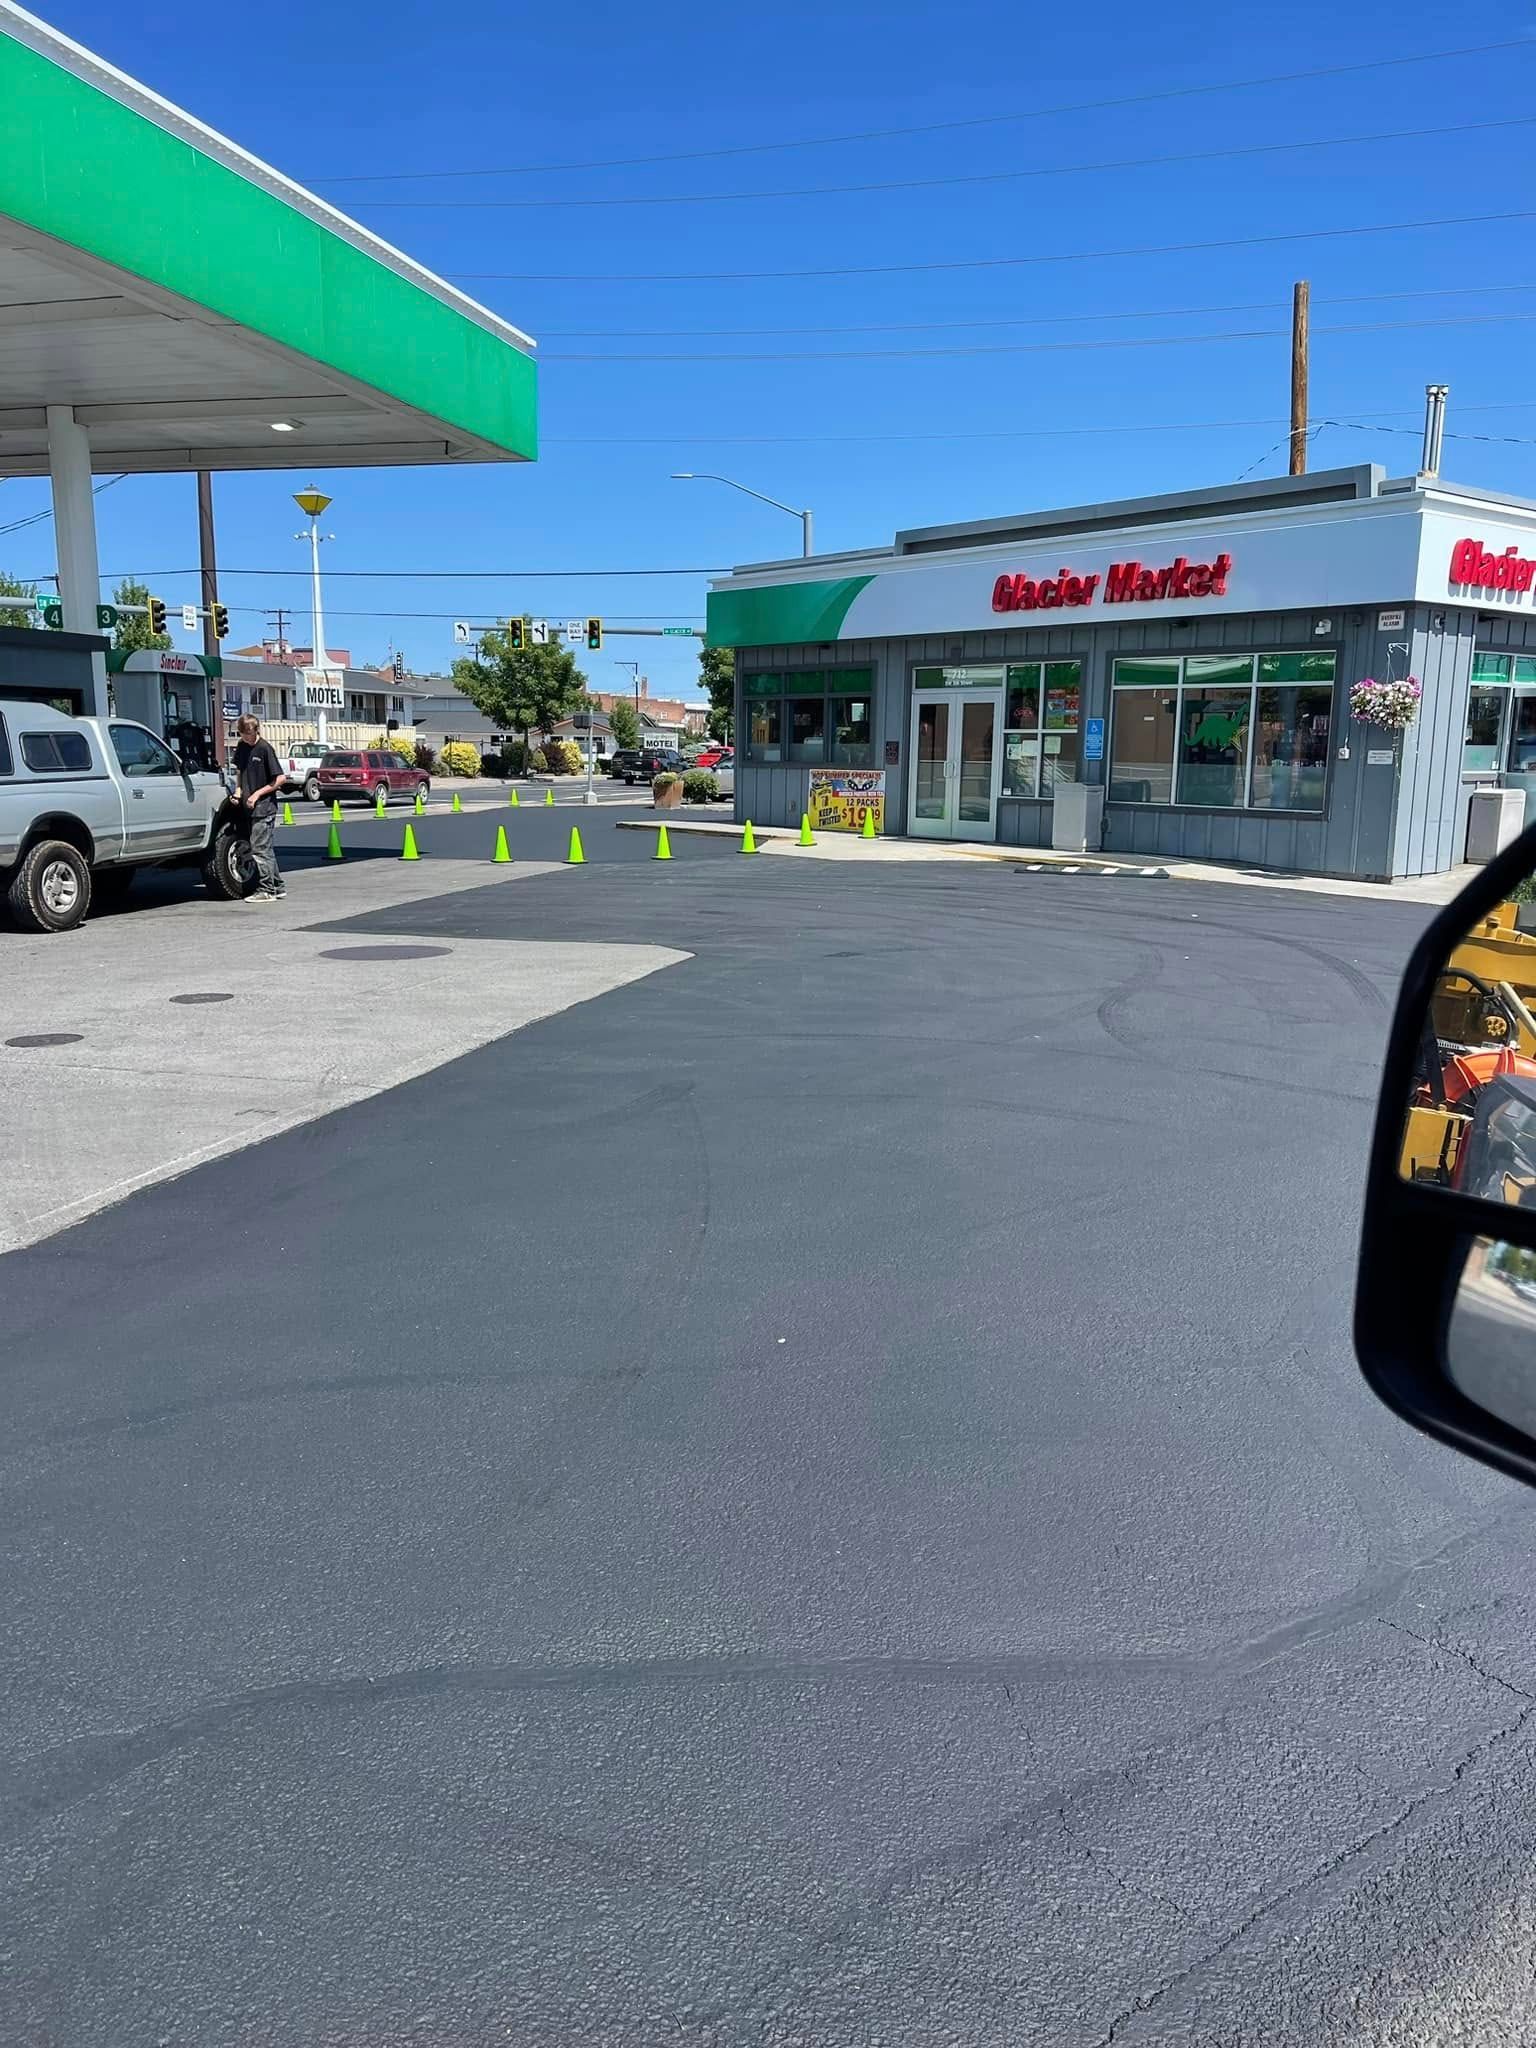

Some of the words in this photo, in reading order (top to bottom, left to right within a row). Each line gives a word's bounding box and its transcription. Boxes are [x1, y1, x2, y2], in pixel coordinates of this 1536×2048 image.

[1449, 538, 1536, 592] Glacier
[992, 568, 1099, 612] Glacier
[1103, 554, 1231, 603] Market
[51, 611, 60, 625] 4
[102, 610, 111, 624] 3
[161, 654, 187, 671] Sinclair
[306, 687, 343, 705] MOTEL
[646, 740, 674, 748] MOTEL
[846, 798, 855, 807] 12
[857, 798, 880, 807] PACKS
[819, 808, 832, 817] KEEP
[833, 806, 838, 815] IT
[819, 815, 841, 827] TWISTED
